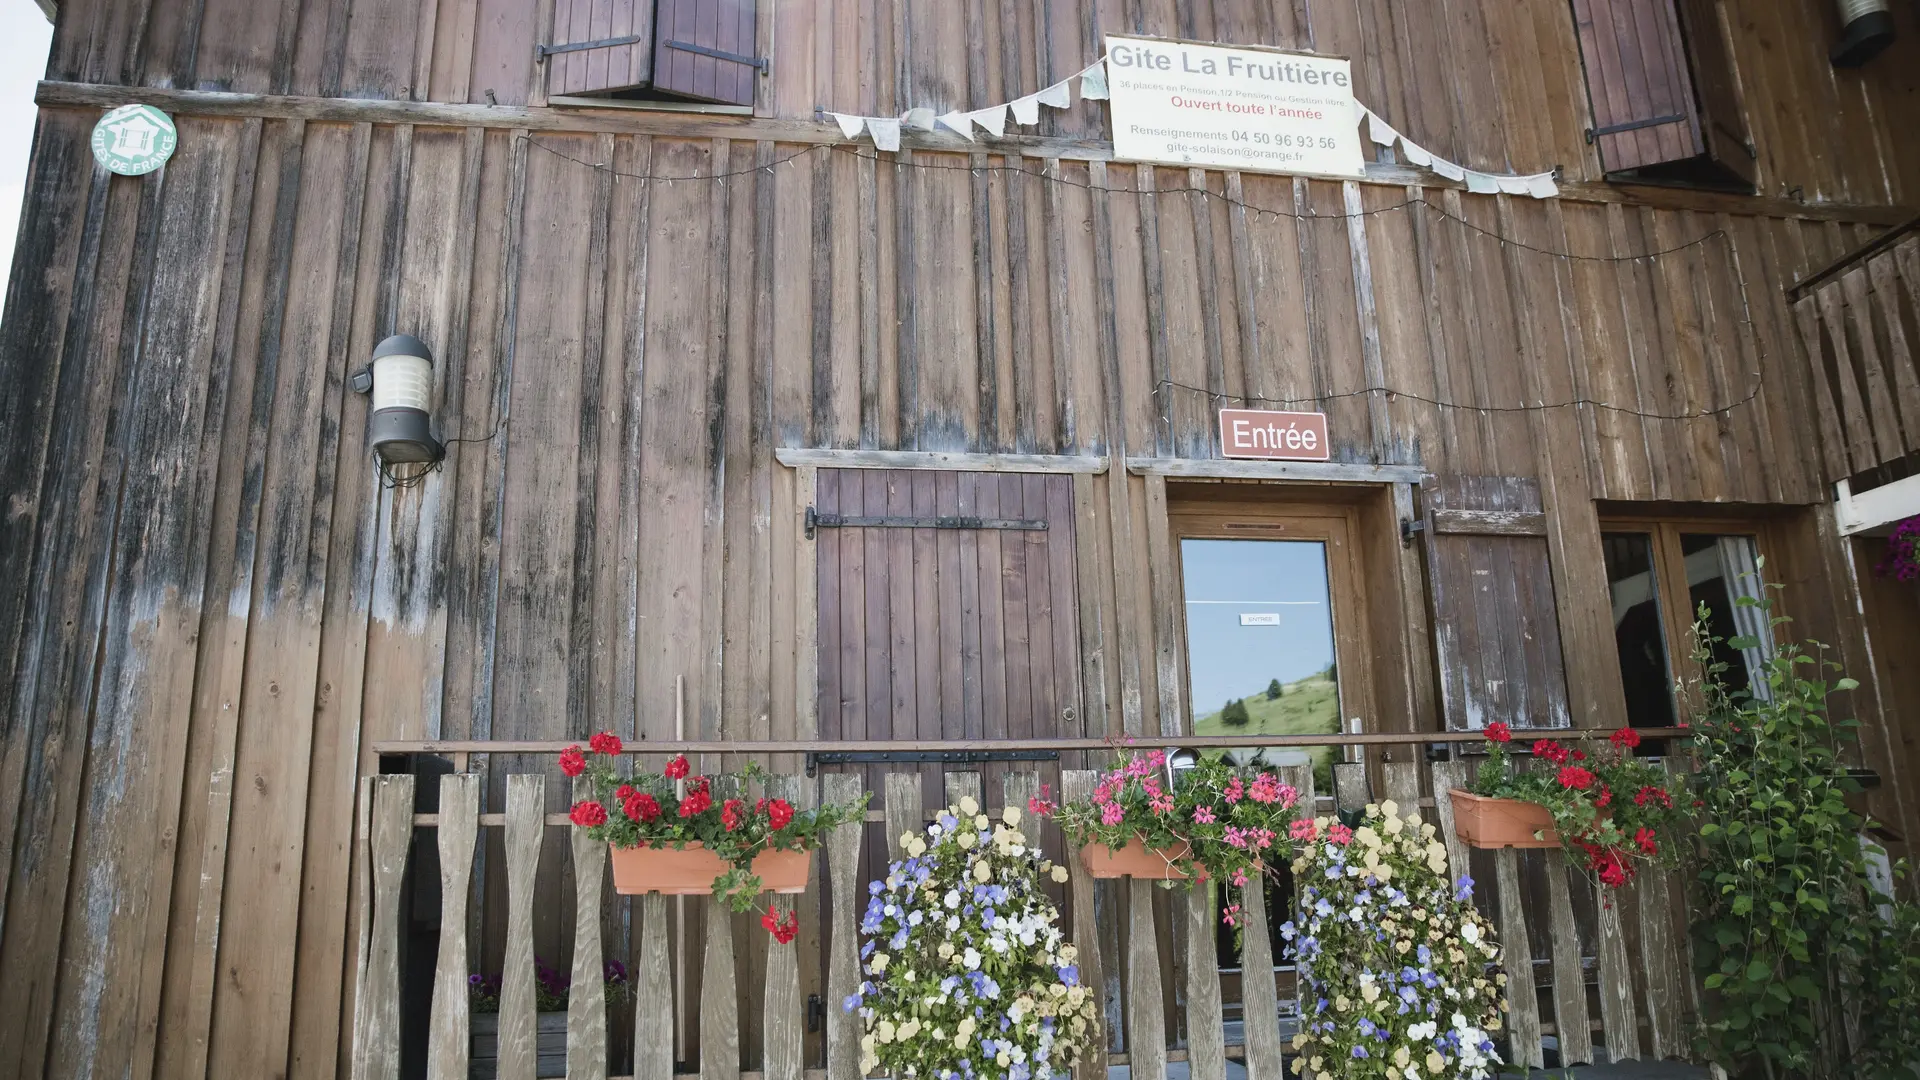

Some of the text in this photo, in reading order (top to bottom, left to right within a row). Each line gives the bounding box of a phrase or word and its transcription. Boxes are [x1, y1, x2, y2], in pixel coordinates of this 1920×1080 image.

[1110, 45, 1348, 88] Gite La Fruitière
[1119, 80, 1131, 89] 36
[1133, 81, 1164, 91] places
[1235, 90, 1272, 100] Pension
[1288, 95, 1323, 105] Gestion
[1171, 95, 1323, 120] Ouvert toute l'année
[1130, 124, 1336, 150] Renseignements 04 50 96 93 56
[109, 159, 129, 172] DE
[132, 135, 174, 174] FRANCE
[1166, 142, 1304, 161] gite-solaison@orange.fr
[1232, 420, 1317, 451] Entrée
